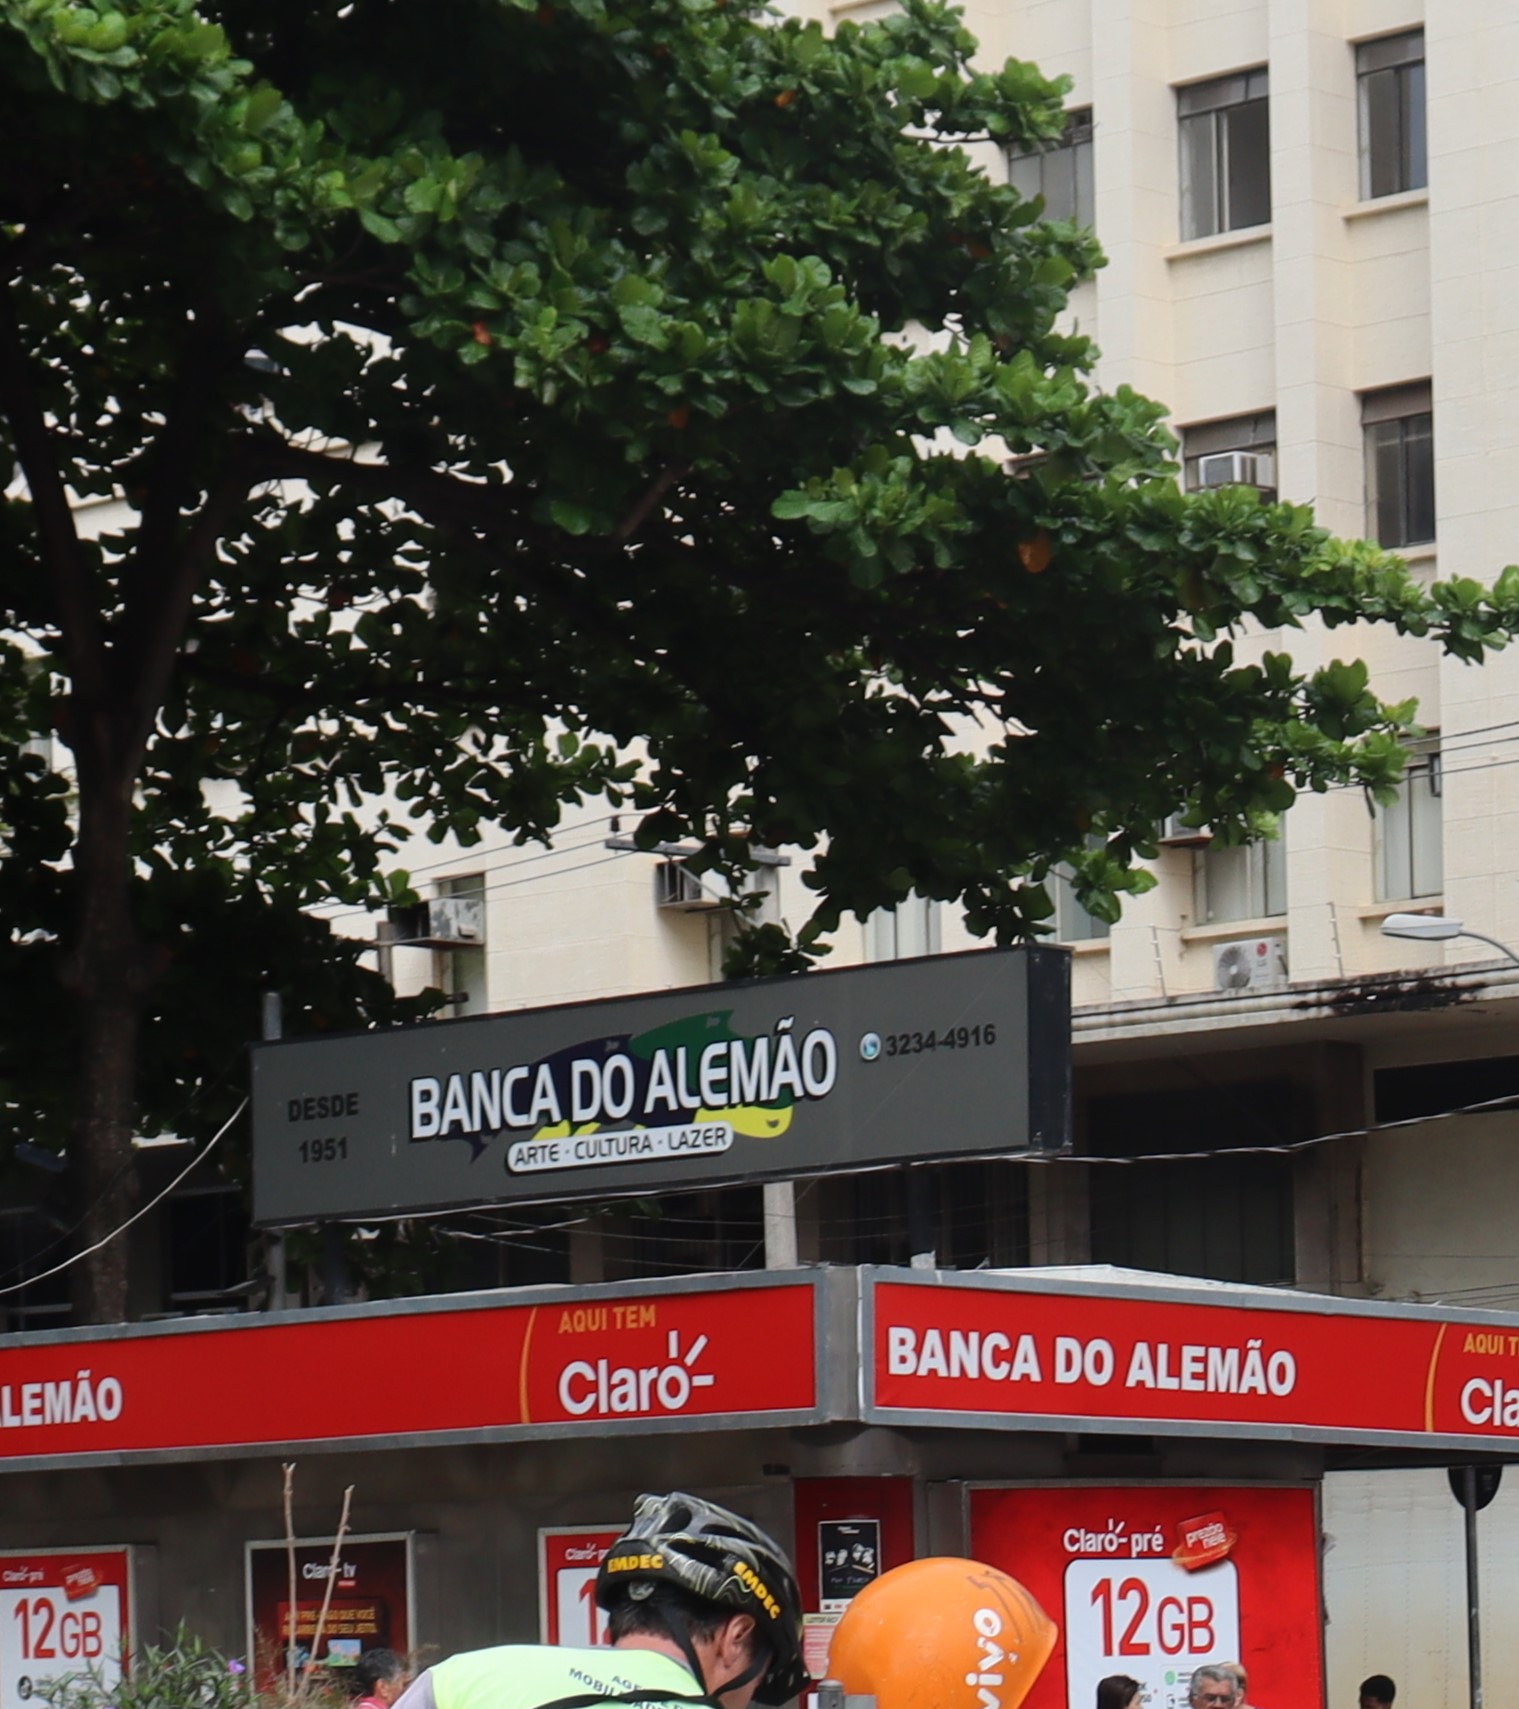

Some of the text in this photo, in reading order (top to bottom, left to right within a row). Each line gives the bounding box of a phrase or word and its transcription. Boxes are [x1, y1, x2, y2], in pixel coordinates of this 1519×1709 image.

[885, 1023, 997, 1057] 3234-4916
[410, 1015, 838, 1139] BANCA DO ALEMÃO
[287, 1092, 360, 1123] DESDE
[299, 1137, 349, 1164] 1951
[513, 1127, 727, 1167] ARTE CULTURA LAZER
[558, 1304, 657, 1334] AQUI TEM
[1463, 1332, 1504, 1355] AQUI
[558, 1354, 693, 1415] Claro
[888, 1326, 1297, 1397] BANCA DO ALEMÃO
[0, 1368, 123, 1428] LEMÃO
[607, 1553, 665, 1574] EMDEC
[1063, 1525, 1165, 1559] Claro pré
[578, 1578, 612, 1645] 1
[732, 1560, 782, 1620] EMDEC
[14, 1597, 102, 1660] 12 GB
[1091, 1576, 1216, 1657] 12 GB
